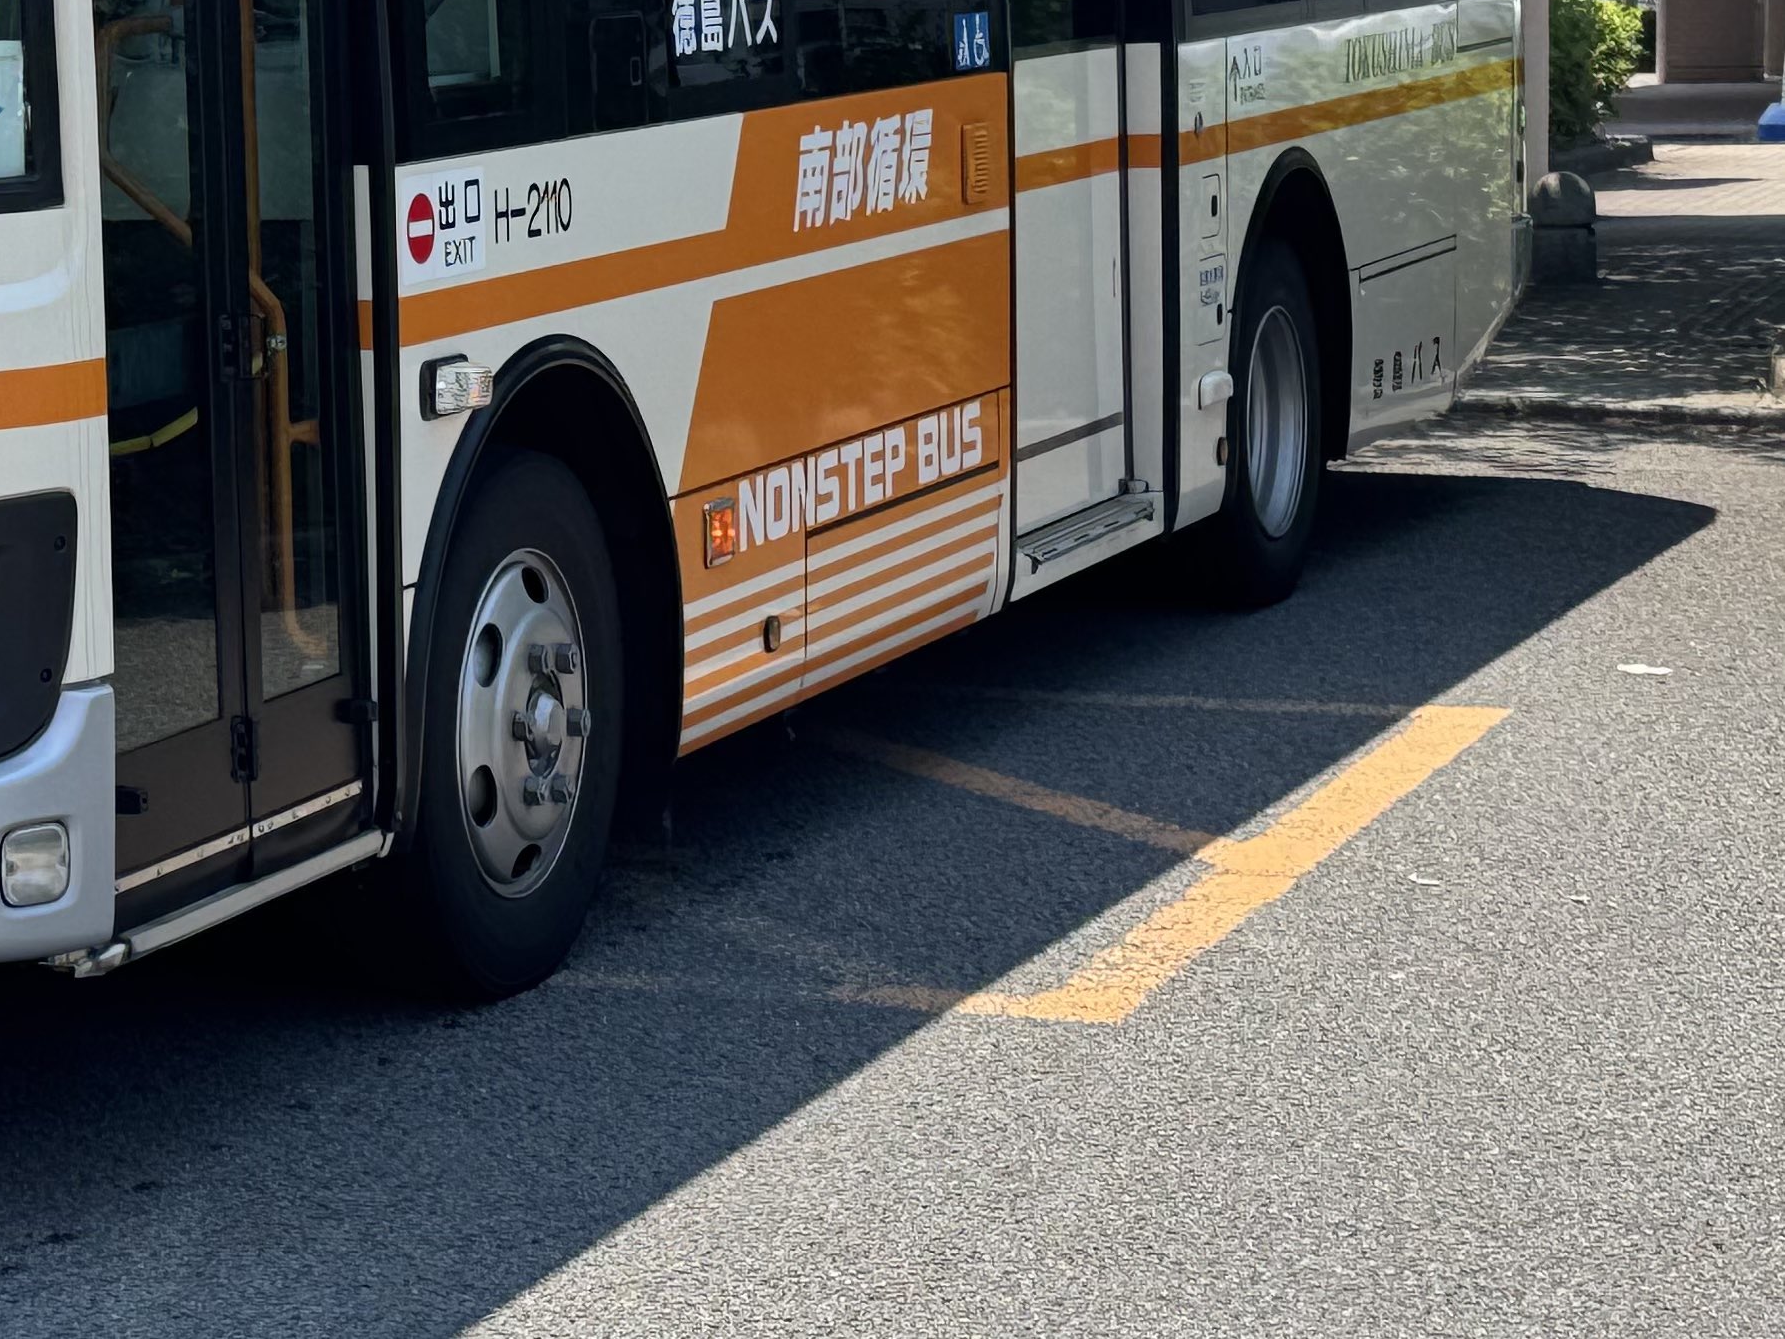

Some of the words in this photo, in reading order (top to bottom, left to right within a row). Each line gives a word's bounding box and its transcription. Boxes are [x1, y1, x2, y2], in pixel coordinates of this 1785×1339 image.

[438, 178, 482, 231] 出口
[792, 108, 934, 233] 南部循環
[494, 177, 573, 245] H-2110
[444, 235, 476, 268] EXIT
[738, 425, 906, 553] NONSTEP
[916, 397, 983, 485] BUS
